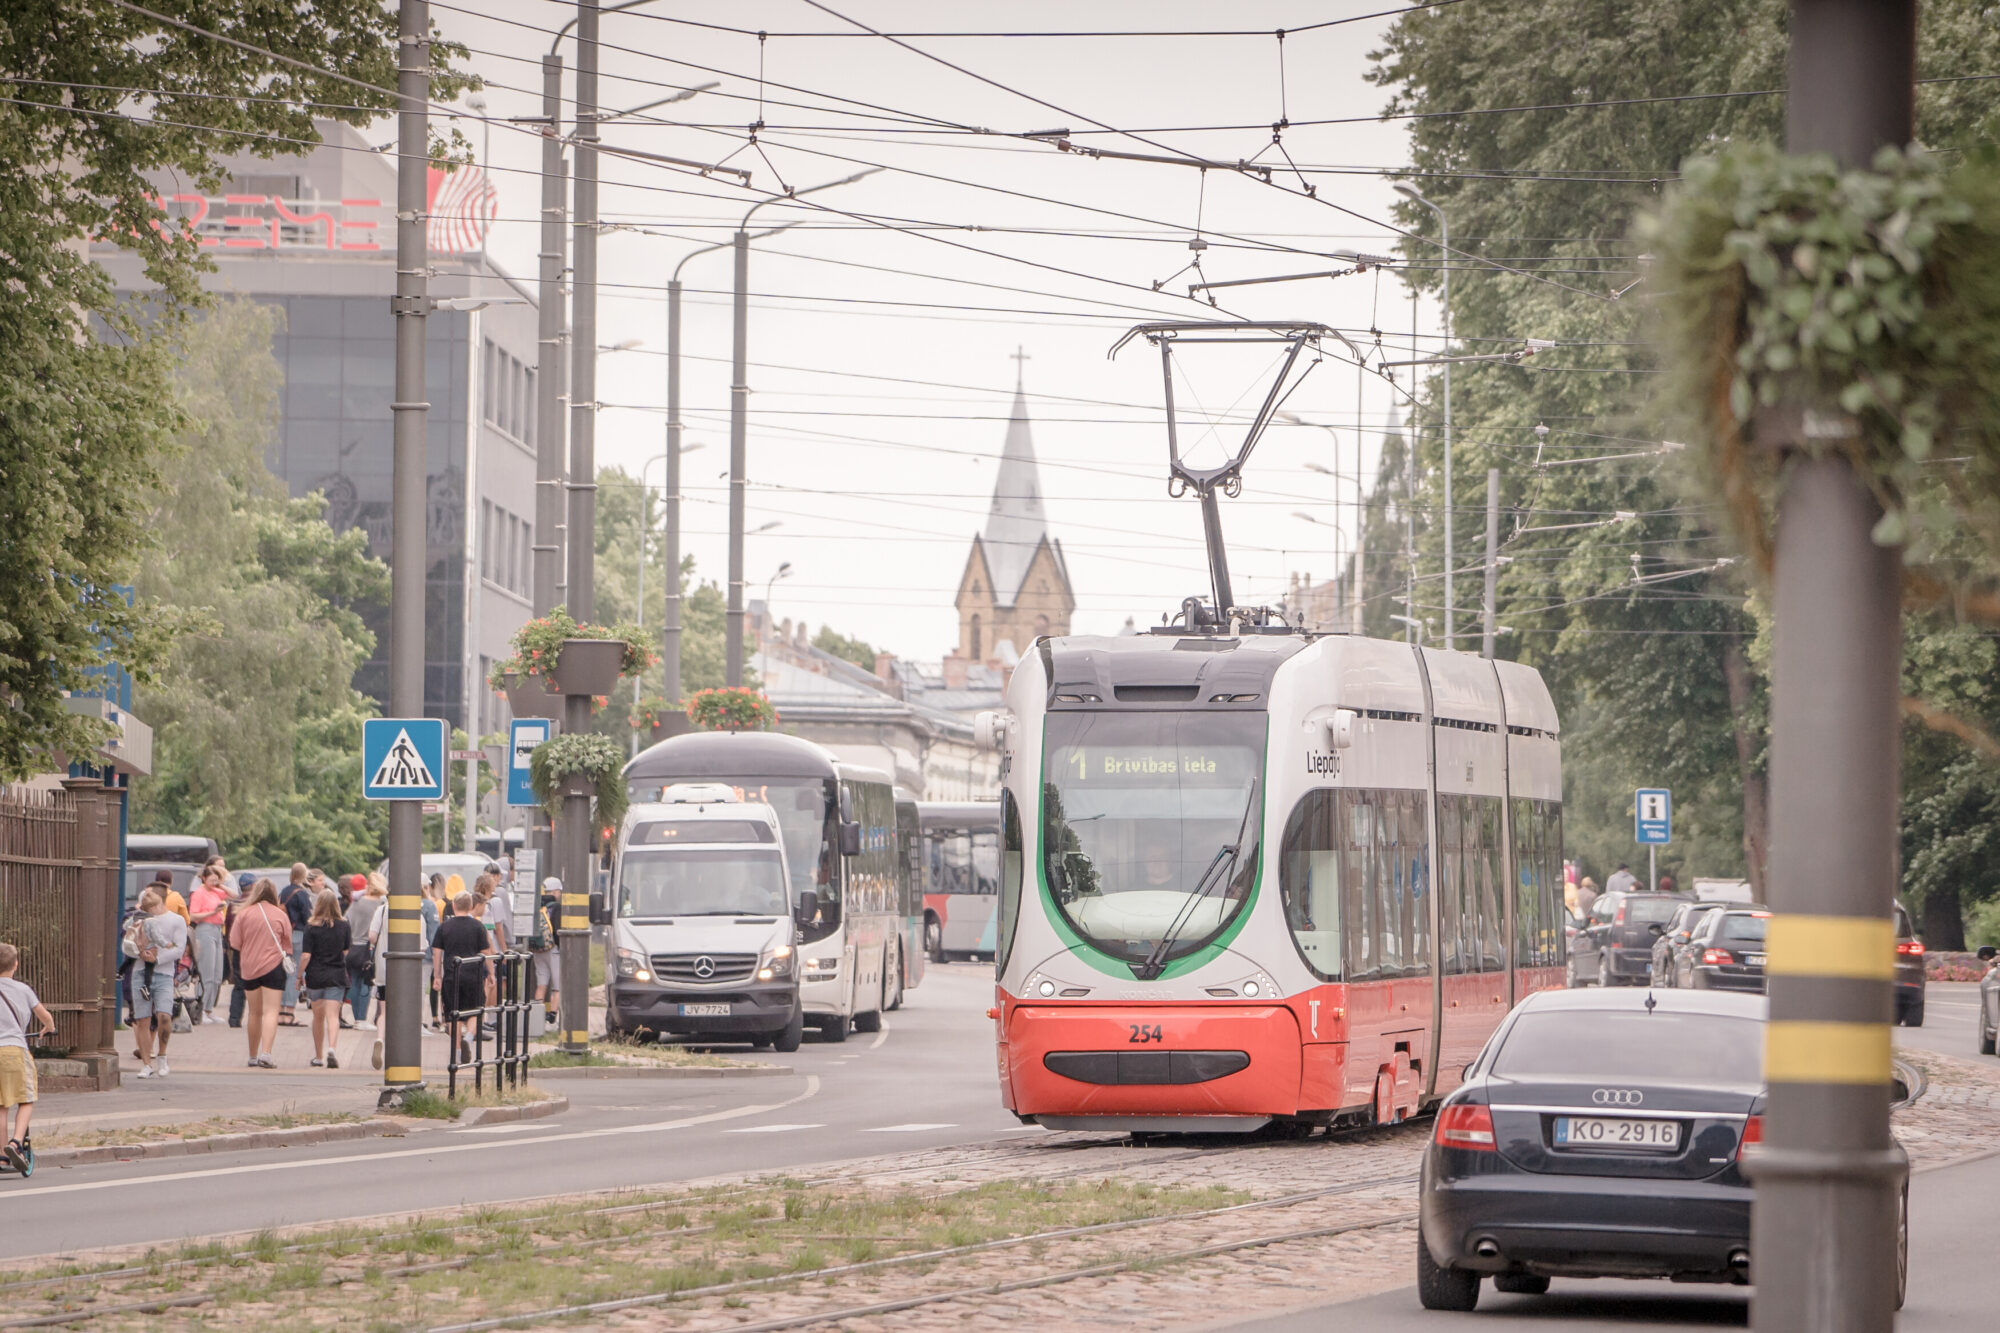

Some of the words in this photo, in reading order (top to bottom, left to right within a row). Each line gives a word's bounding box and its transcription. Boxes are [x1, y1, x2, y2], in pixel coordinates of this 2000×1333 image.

[1070, 749, 1086, 780] 1
[1184, 755, 1217, 773] iela
[1128, 1024, 1163, 1043] 254
[1572, 1121, 1674, 1143] KO-2916
